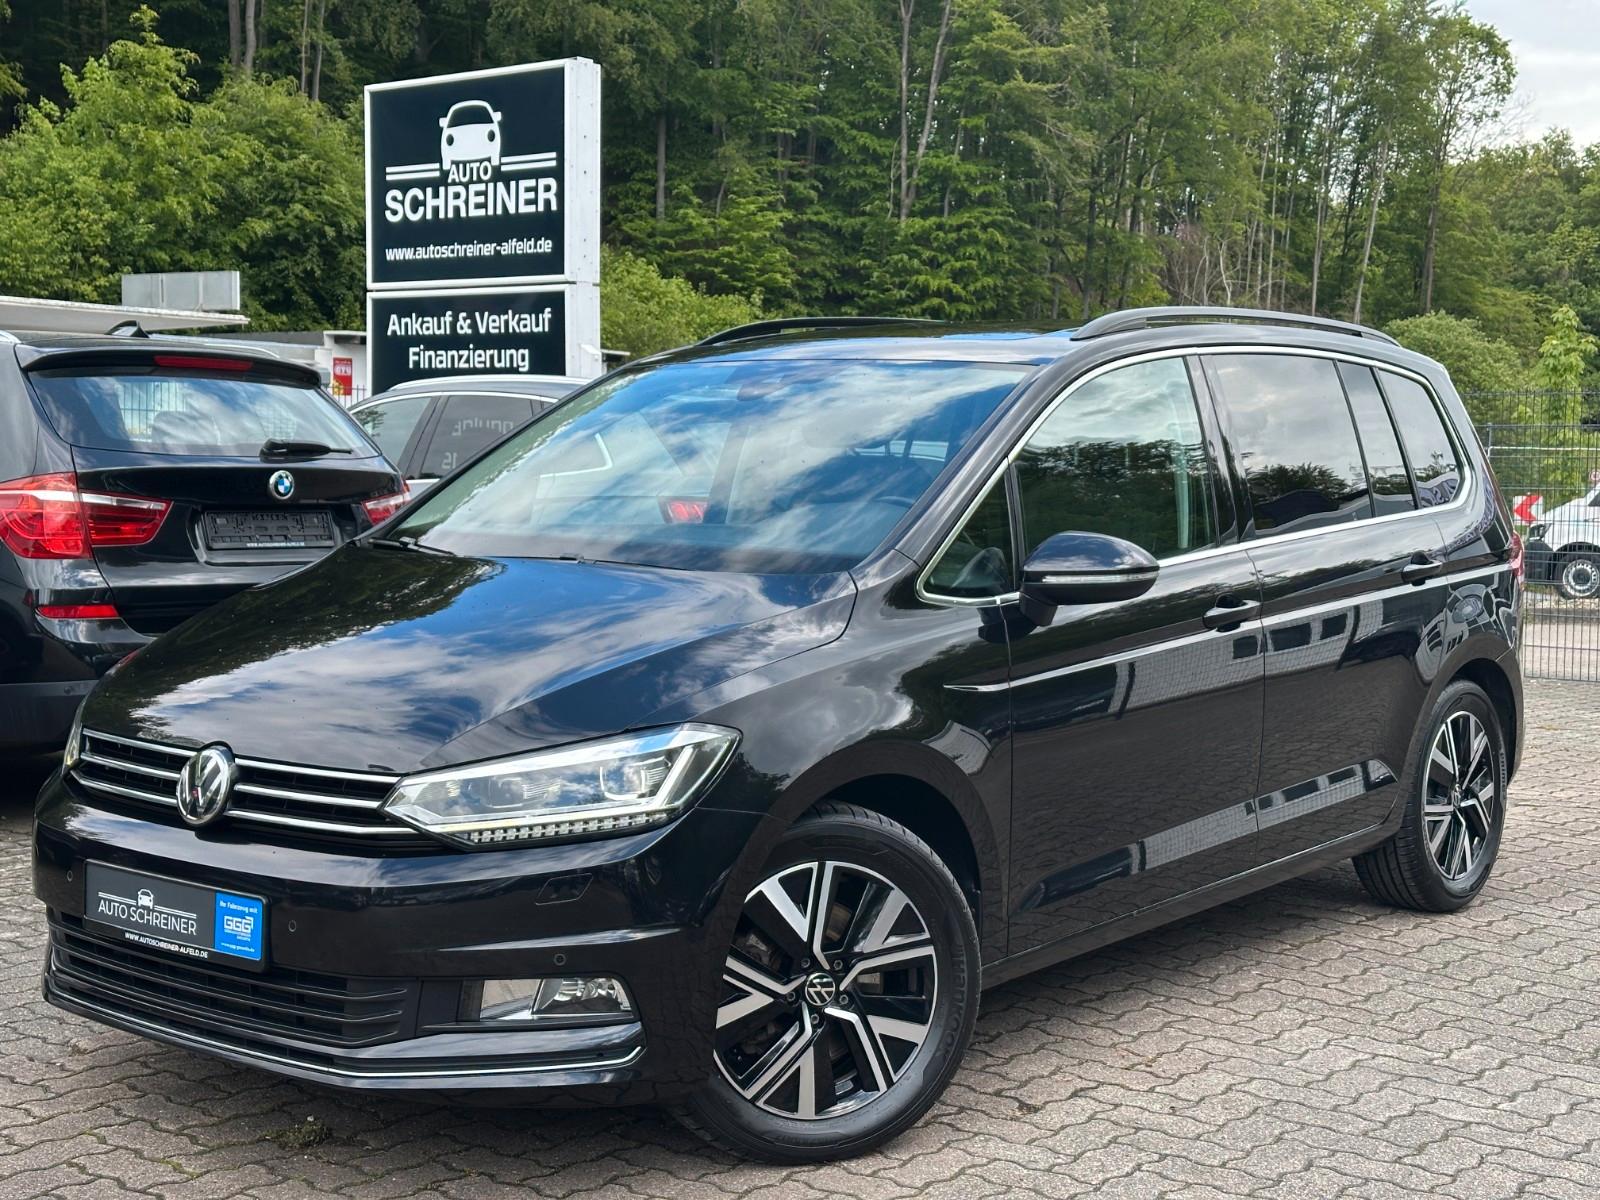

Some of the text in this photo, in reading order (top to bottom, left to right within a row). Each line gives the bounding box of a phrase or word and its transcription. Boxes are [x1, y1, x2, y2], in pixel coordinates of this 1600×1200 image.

[447, 160, 492, 183] AUTO
[384, 176, 558, 223] SCHREINER
[385, 237, 553, 261] www.autoschreiner-alfeld.de
[386, 307, 552, 336] Ankauf & Verkauf
[408, 343, 530, 373] Finanzierung
[98, 899, 129, 919] AUTO
[129, 906, 198, 936] SCHREINER
[124, 931, 209, 959] WWW.AUTOSCHREINER-ALFELD.DE
